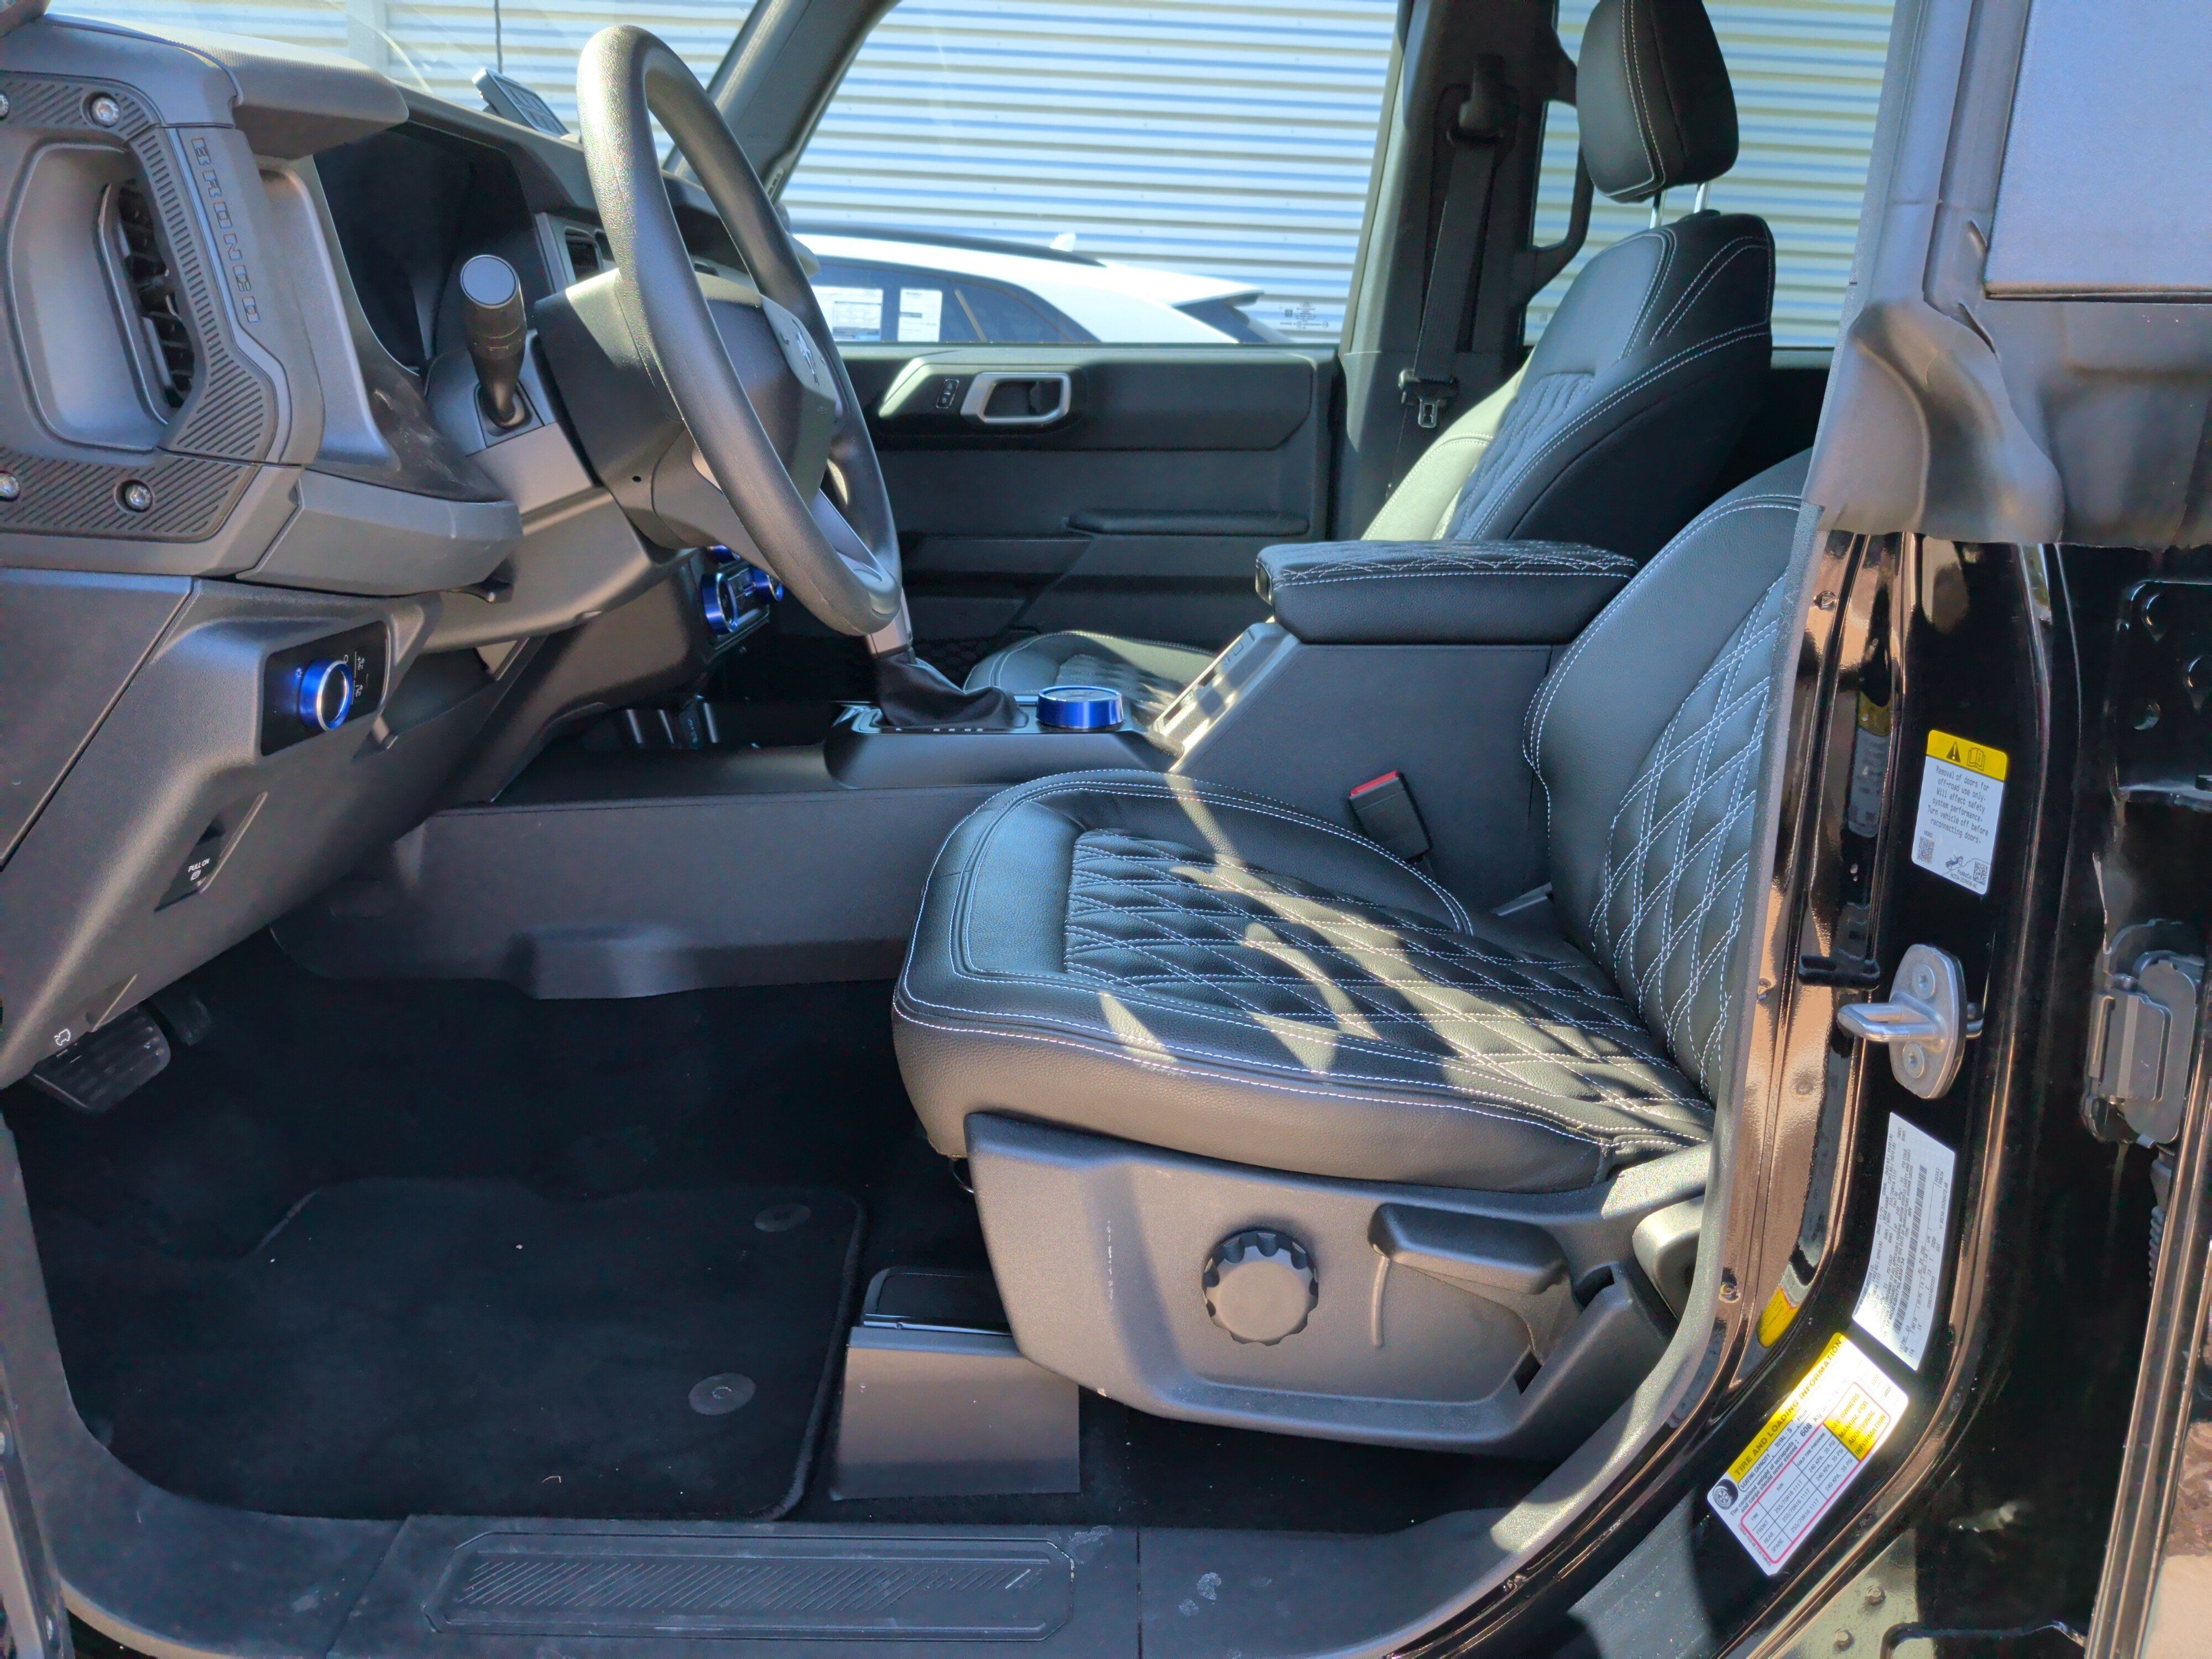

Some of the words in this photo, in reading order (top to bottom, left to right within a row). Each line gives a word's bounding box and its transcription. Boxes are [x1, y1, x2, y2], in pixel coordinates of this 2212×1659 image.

[191, 137, 260, 323] BRONCO
[1936, 765, 1954, 779] Removal
[1955, 773, 1961, 781] of
[1964, 776, 1978, 787] doors
[1980, 781, 1989, 791] for
[1937, 776, 1959, 791] off-road
[1961, 787, 1970, 796] use
[1971, 790, 1986, 804] only.
[1932, 797, 1948, 811] system
[1950, 803, 1983, 823] performance.
[1936, 787, 1947, 797] Will
[1949, 792, 1965, 805] affect
[1968, 799, 1985, 814] safety
[1927, 804, 1938, 816] Turn
[1940, 810, 1959, 824] vehicle
[1960, 818, 1969, 828] off
[1971, 822, 1989, 836] before
[1929, 817, 1962, 838] reconnecting
[1964, 831, 1981, 844] doors.
[188, 862, 201, 872] PULL
[201, 858, 210, 867] ON
[1957, 869, 1972, 880] FoMoCo
[1884, 1281, 1892, 1305] CONFORMS
[1886, 1284, 1896, 1310] STANDARDS
[1734, 1454, 1752, 1477] TIRE
[1751, 1436, 1767, 1457] AND
[1766, 1397, 1799, 1438] LOADING
[1798, 1339, 1841, 1400] INFORMATION
[1830, 1418, 1841, 1431] SEE
[1847, 1409, 1876, 1446] ADDITIONAL
[1854, 1413, 1887, 1456] INFORMATION
[1796, 1456, 1805, 1467] COLD
[1810, 1431, 1825, 1450] PRESSURE
[1729, 1505, 1739, 1517] The
[1737, 1484, 1757, 1509] combined
[1755, 1468, 1771, 1486] weight
[1773, 1439, 1794, 1466] occupants
[1740, 1502, 1749, 1514] and
[1748, 1489, 1761, 1505] cargo
[1759, 1473, 1773, 1491] should
[1772, 1460, 1784, 1475] never
[1782, 1444, 1798, 1463] exceed
[1799, 1421, 1813, 1438] 608
[1740, 1471, 1755, 1490] SEATING
[1753, 1452, 1770, 1473] CAPACITY
[1756, 1519, 1768, 1536] FRONT
[1773, 1489, 1794, 1515] 255/70R16
[1793, 1479, 1803, 1491] 111T
[1808, 1463, 1816, 1473] 240
[1763, 1531, 1774, 1545] REAR
[1781, 1498, 1802, 1524] 255/70R16
[1800, 1487, 1810, 1500] 111T
[1815, 1471, 1824, 1481] 240
[1771, 1537, 1783, 1553] SPARE
[1790, 1507, 1811, 1533] 255/70R16
[1809, 1497, 1819, 1510] 111T
[1824, 1481, 1833, 1491] 240
[1840, 1464, 1847, 1473] 35
